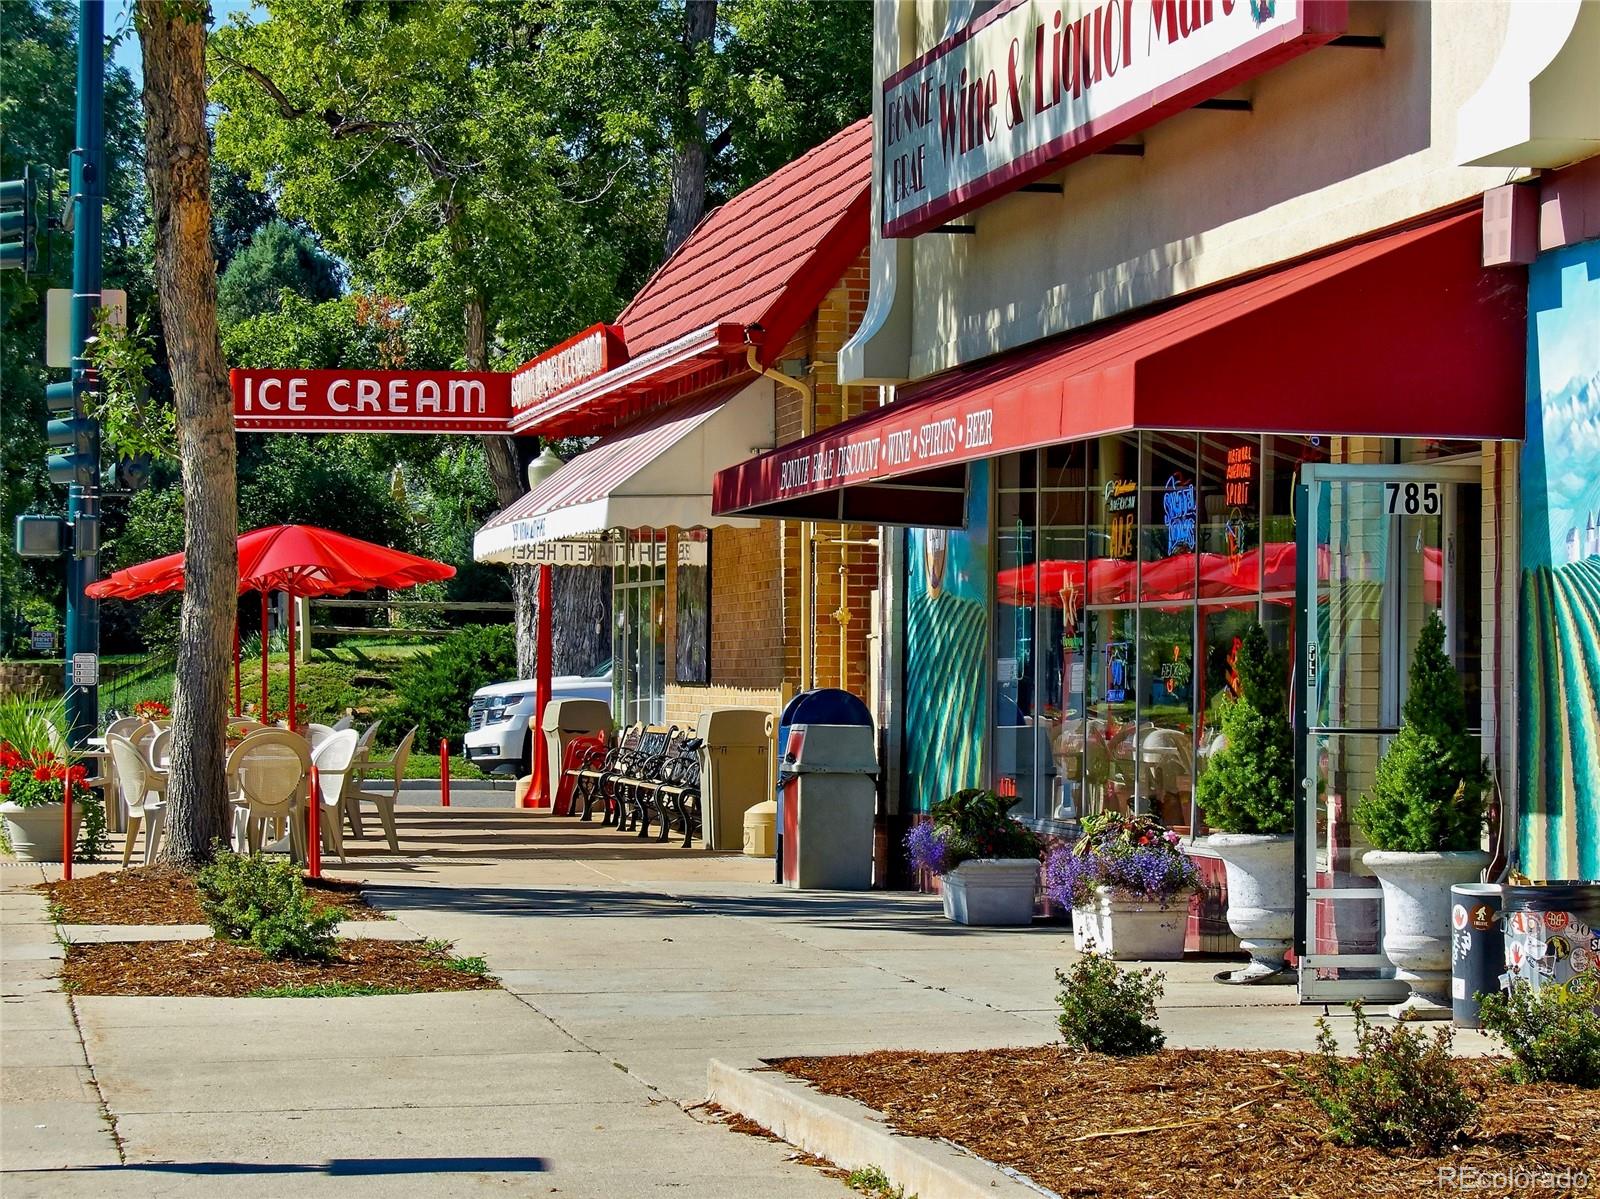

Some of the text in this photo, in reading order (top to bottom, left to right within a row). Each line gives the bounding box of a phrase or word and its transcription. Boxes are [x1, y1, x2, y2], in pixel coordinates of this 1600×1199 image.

[939, 0, 1236, 169] Wine & Liquor Ma
[887, 76, 934, 148] BONNIE
[893, 143, 926, 203] BRAE
[244, 377, 487, 414] ICE CREAM
[780, 408, 993, 490] BONNIE BRAE DISCOUNT WINE SPIRITS BEER
[1227, 481, 1250, 506] SPIRIT
[1385, 482, 1440, 515] 785
[1110, 513, 1134, 558] ALE
[1308, 645, 1316, 677] PULL
[1570, 922, 1591, 937] 90
